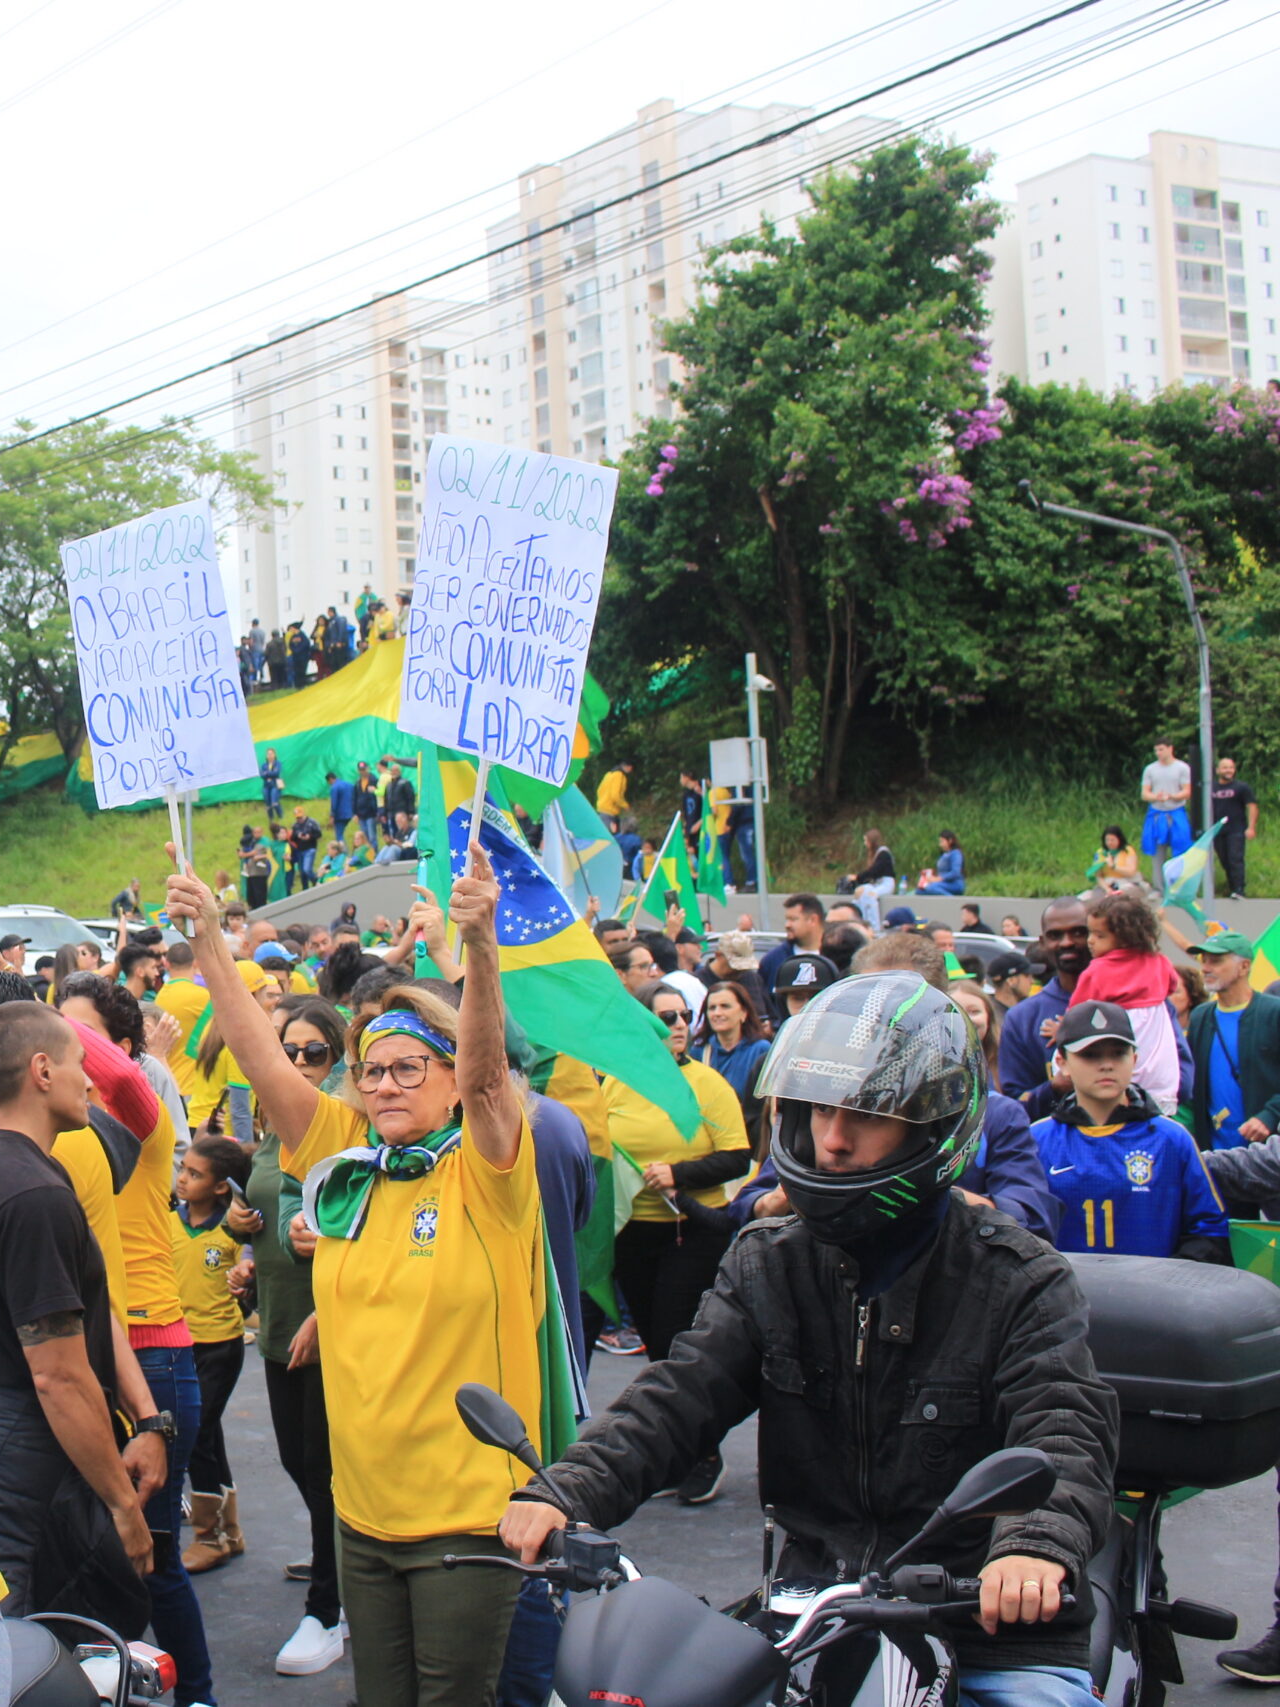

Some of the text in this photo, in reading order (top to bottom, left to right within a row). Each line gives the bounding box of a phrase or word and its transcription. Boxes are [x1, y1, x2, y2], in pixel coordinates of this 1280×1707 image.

[438, 446, 605, 537] 02/11/2022
[65, 514, 211, 583] 02/11/2022
[419, 502, 466, 566] NÃO
[74, 595, 97, 651] O
[409, 608, 446, 660] POR
[414, 569, 592, 652] SER GOVERNADOS
[151, 726, 176, 758] NO
[407, 654, 571, 784] FORA LADRÃO
[98, 750, 195, 804] PODER
[1081, 1199, 1115, 1248] 11
[588, 1689, 647, 1707] HONDA
[920, 1667, 951, 1707] ONDA
